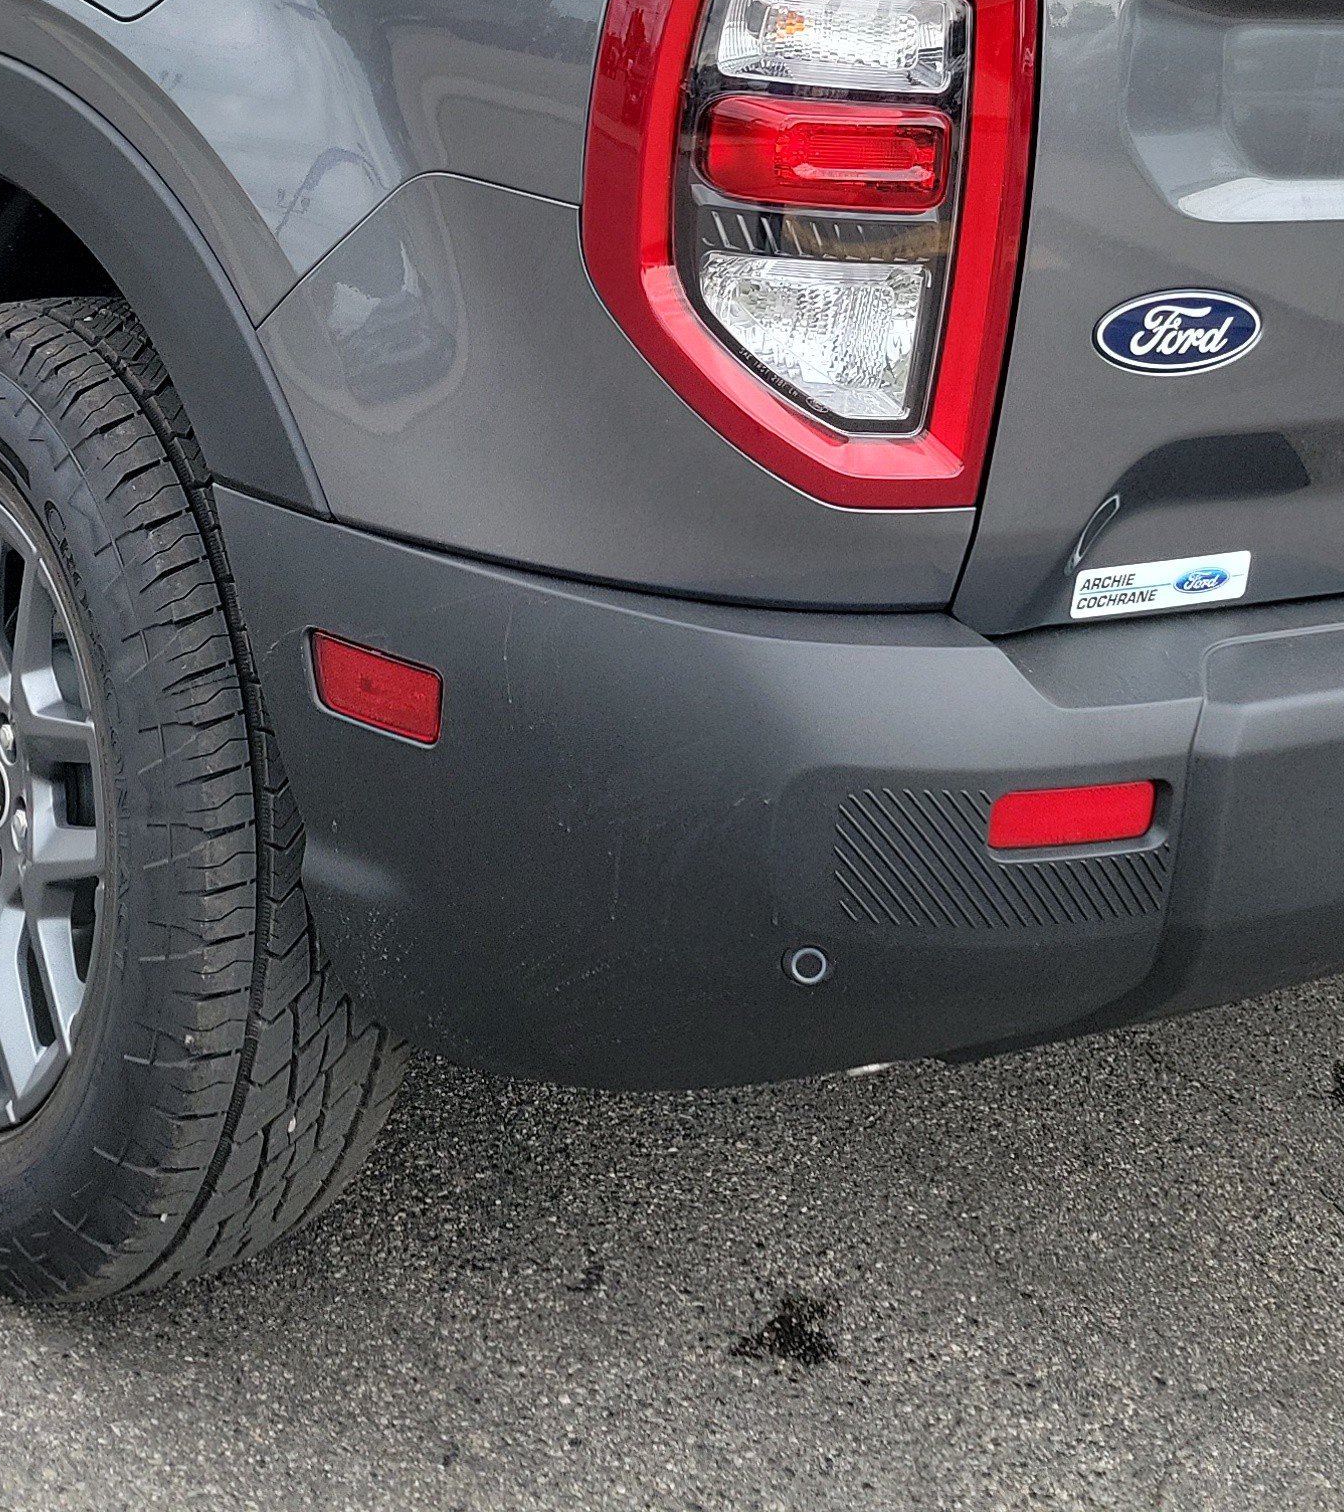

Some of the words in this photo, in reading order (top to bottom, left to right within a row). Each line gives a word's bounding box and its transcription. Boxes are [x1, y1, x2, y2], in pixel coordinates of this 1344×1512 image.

[1130, 304, 1234, 356] Ford
[1079, 573, 1136, 592] ARCHIE
[1183, 571, 1220, 591] Ford
[1076, 589, 1158, 610] COCHRANE
